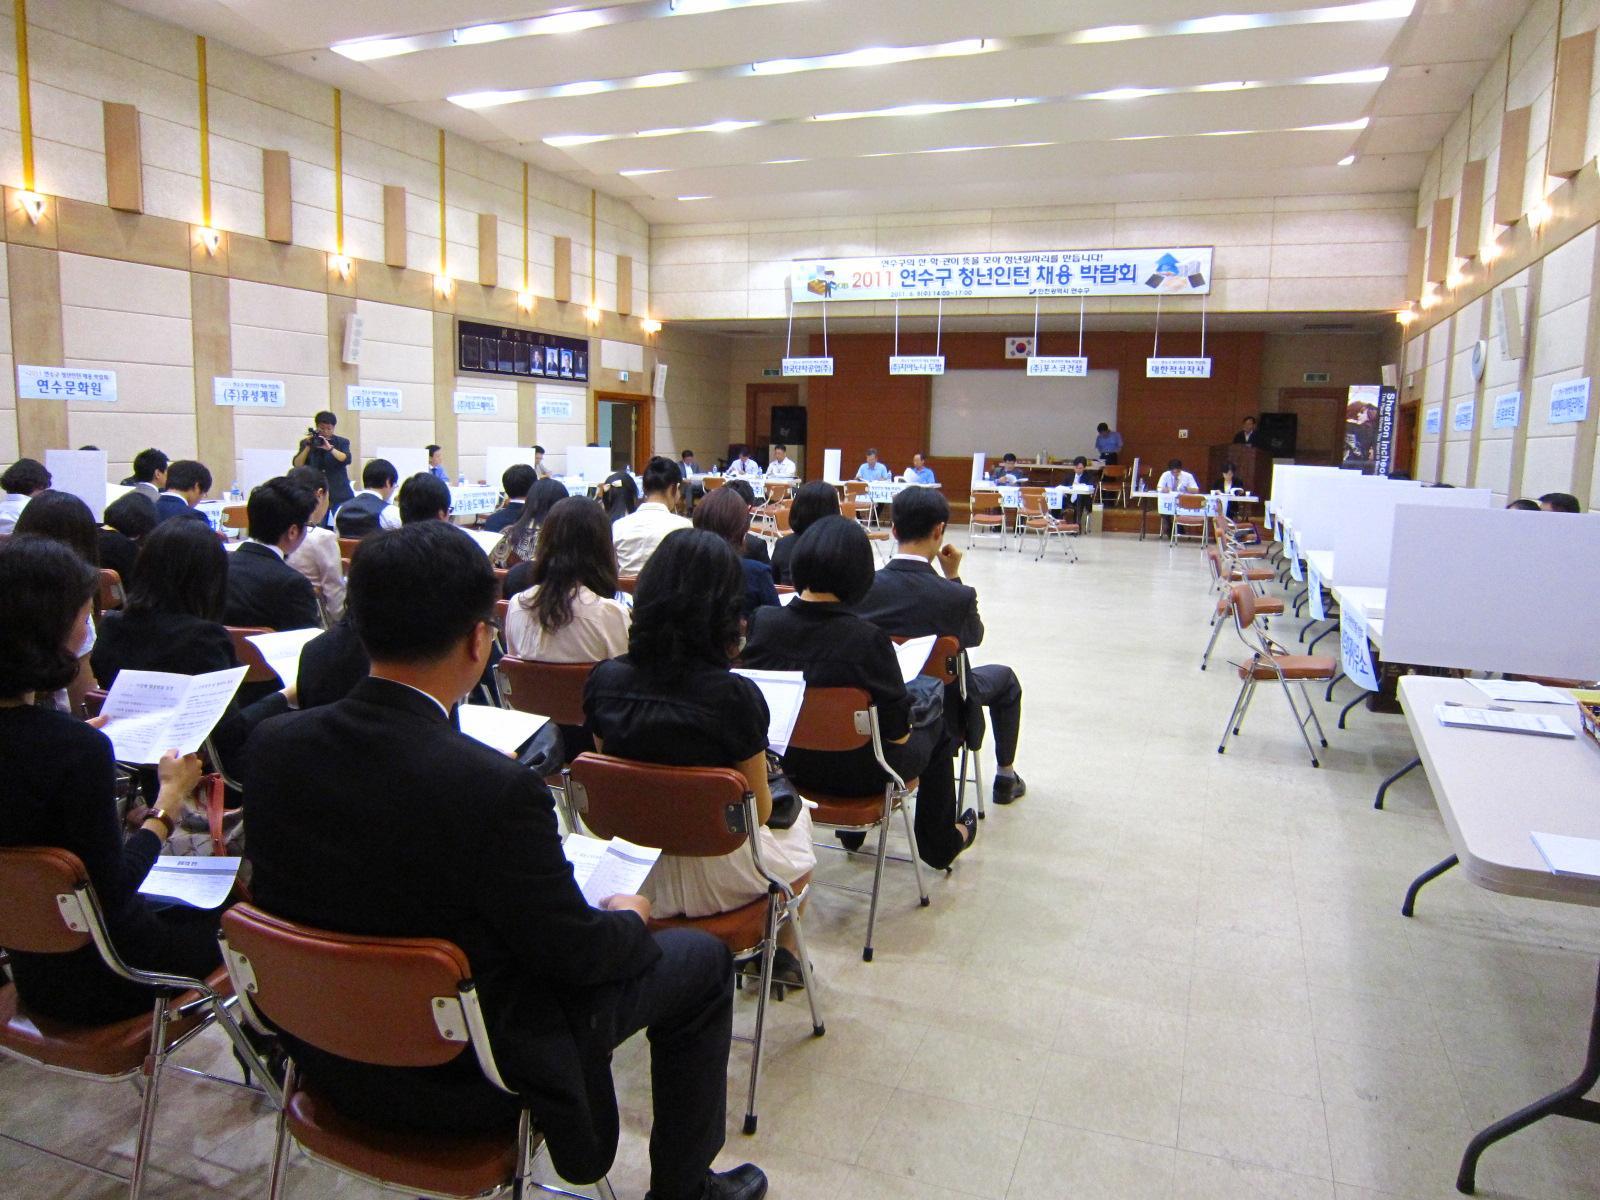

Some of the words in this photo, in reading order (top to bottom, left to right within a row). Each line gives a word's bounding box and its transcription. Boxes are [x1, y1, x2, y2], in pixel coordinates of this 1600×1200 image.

[881, 258, 915, 268] 연수구의
[983, 255, 1002, 264] 모아
[1004, 254, 1059, 265] 청년일자리를
[1062, 253, 1104, 264] 만듭니다!
[852, 270, 894, 289] 2011
[900, 267, 952, 288] 연수구
[958, 265, 1030, 288] 청년인턴
[1036, 264, 1073, 286] 채용
[1080, 262, 1137, 285] 박람회
[1071, 286, 1091, 295] 연수구
[1151, 364, 1205, 376] 대한적십자사
[36, 378, 102, 397] 연수문화원
[1382, 393, 1396, 438] Sheraton
[1380, 441, 1390, 476] Incheo
